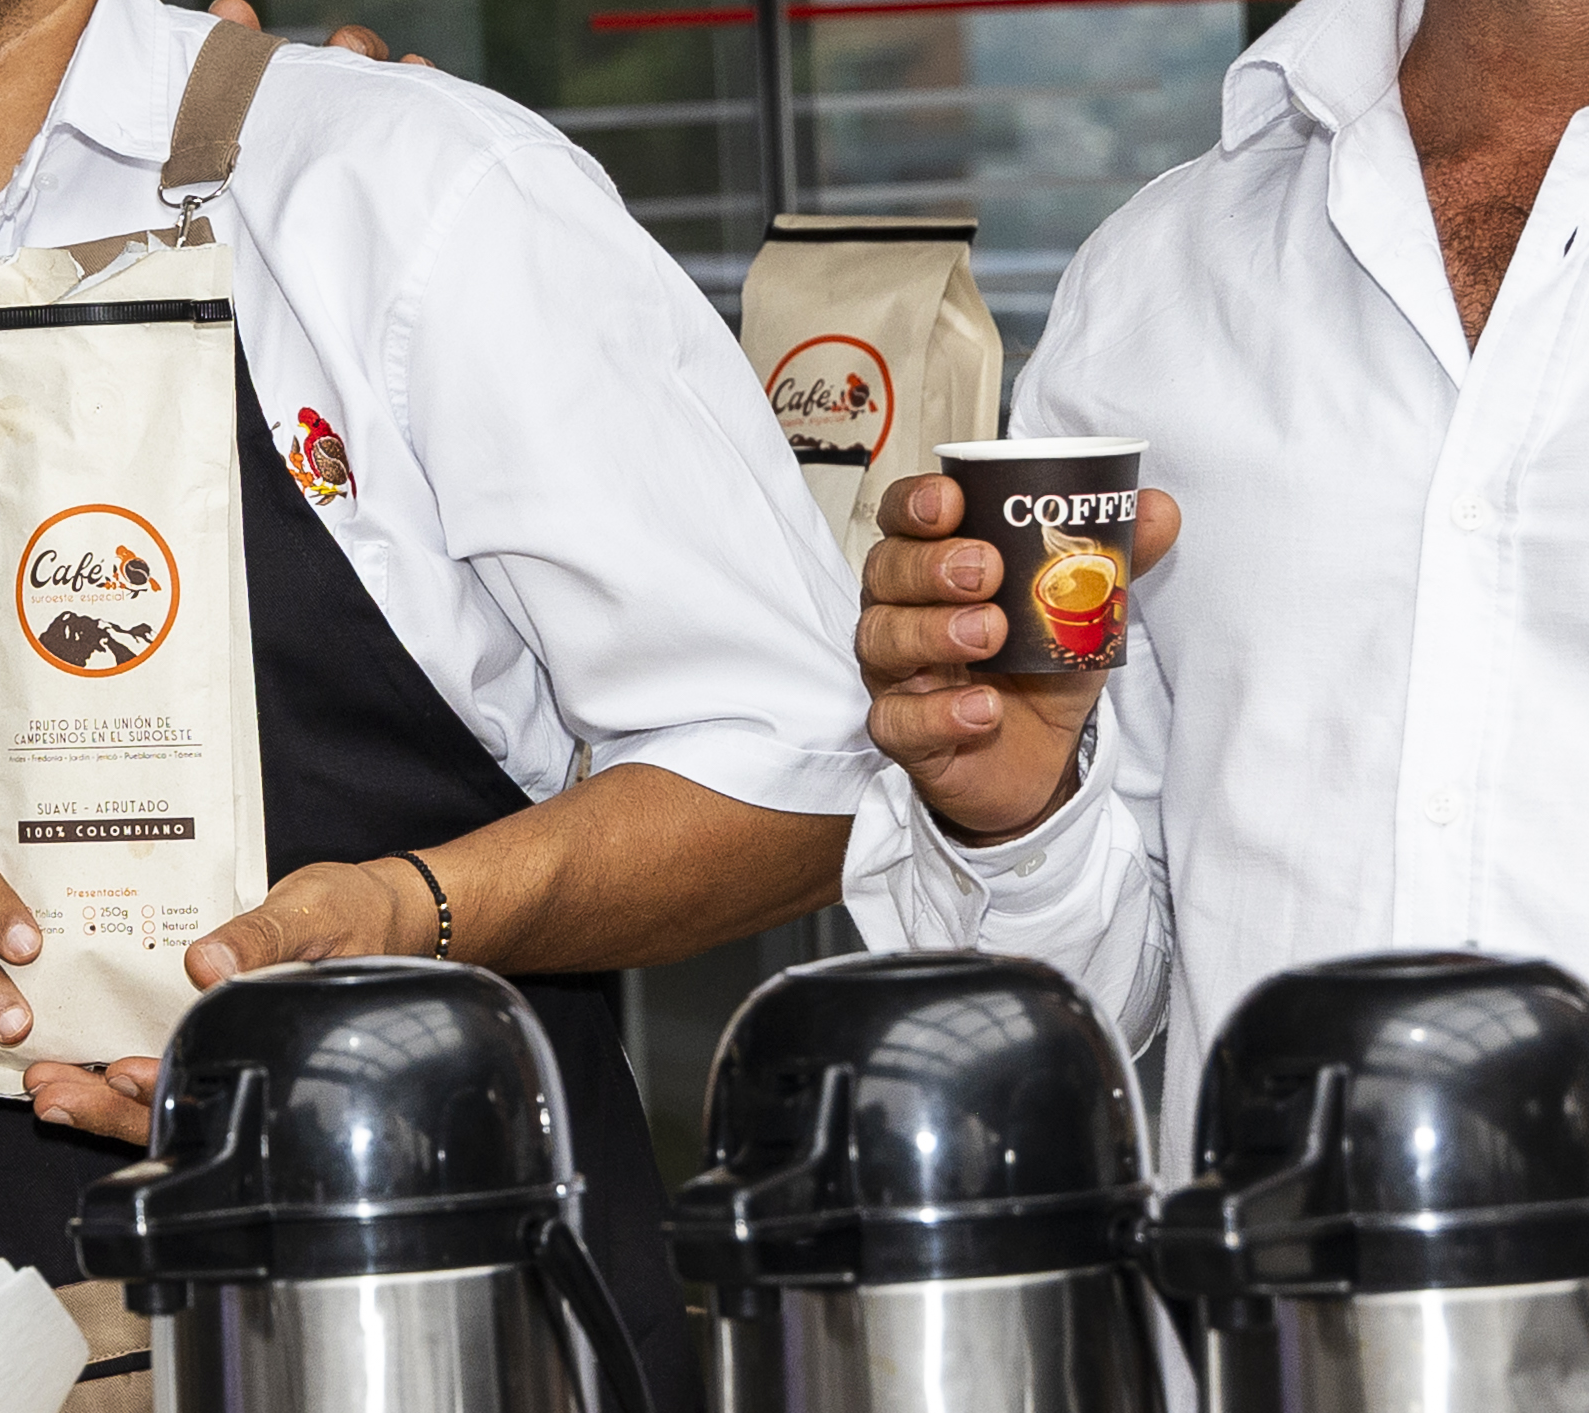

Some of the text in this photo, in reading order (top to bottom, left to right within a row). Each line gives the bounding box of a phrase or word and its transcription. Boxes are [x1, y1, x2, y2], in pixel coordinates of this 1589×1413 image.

[773, 377, 834, 417] Café
[30, 549, 106, 592] Café
[31, 591, 125, 605] suroeste especial
[29, 715, 172, 731] FRUTO DE LA UNIÓN DE
[14, 729, 193, 745] CAMPESINOS EN EL SUROESTE
[37, 800, 169, 815] SUAVE AFRUTADO
[25, 824, 185, 838] 100% COLOMBIANO
[100, 907, 129, 920] 250g
[161, 905, 199, 915] Lavado
[100, 921, 198, 936] 500g Natural
